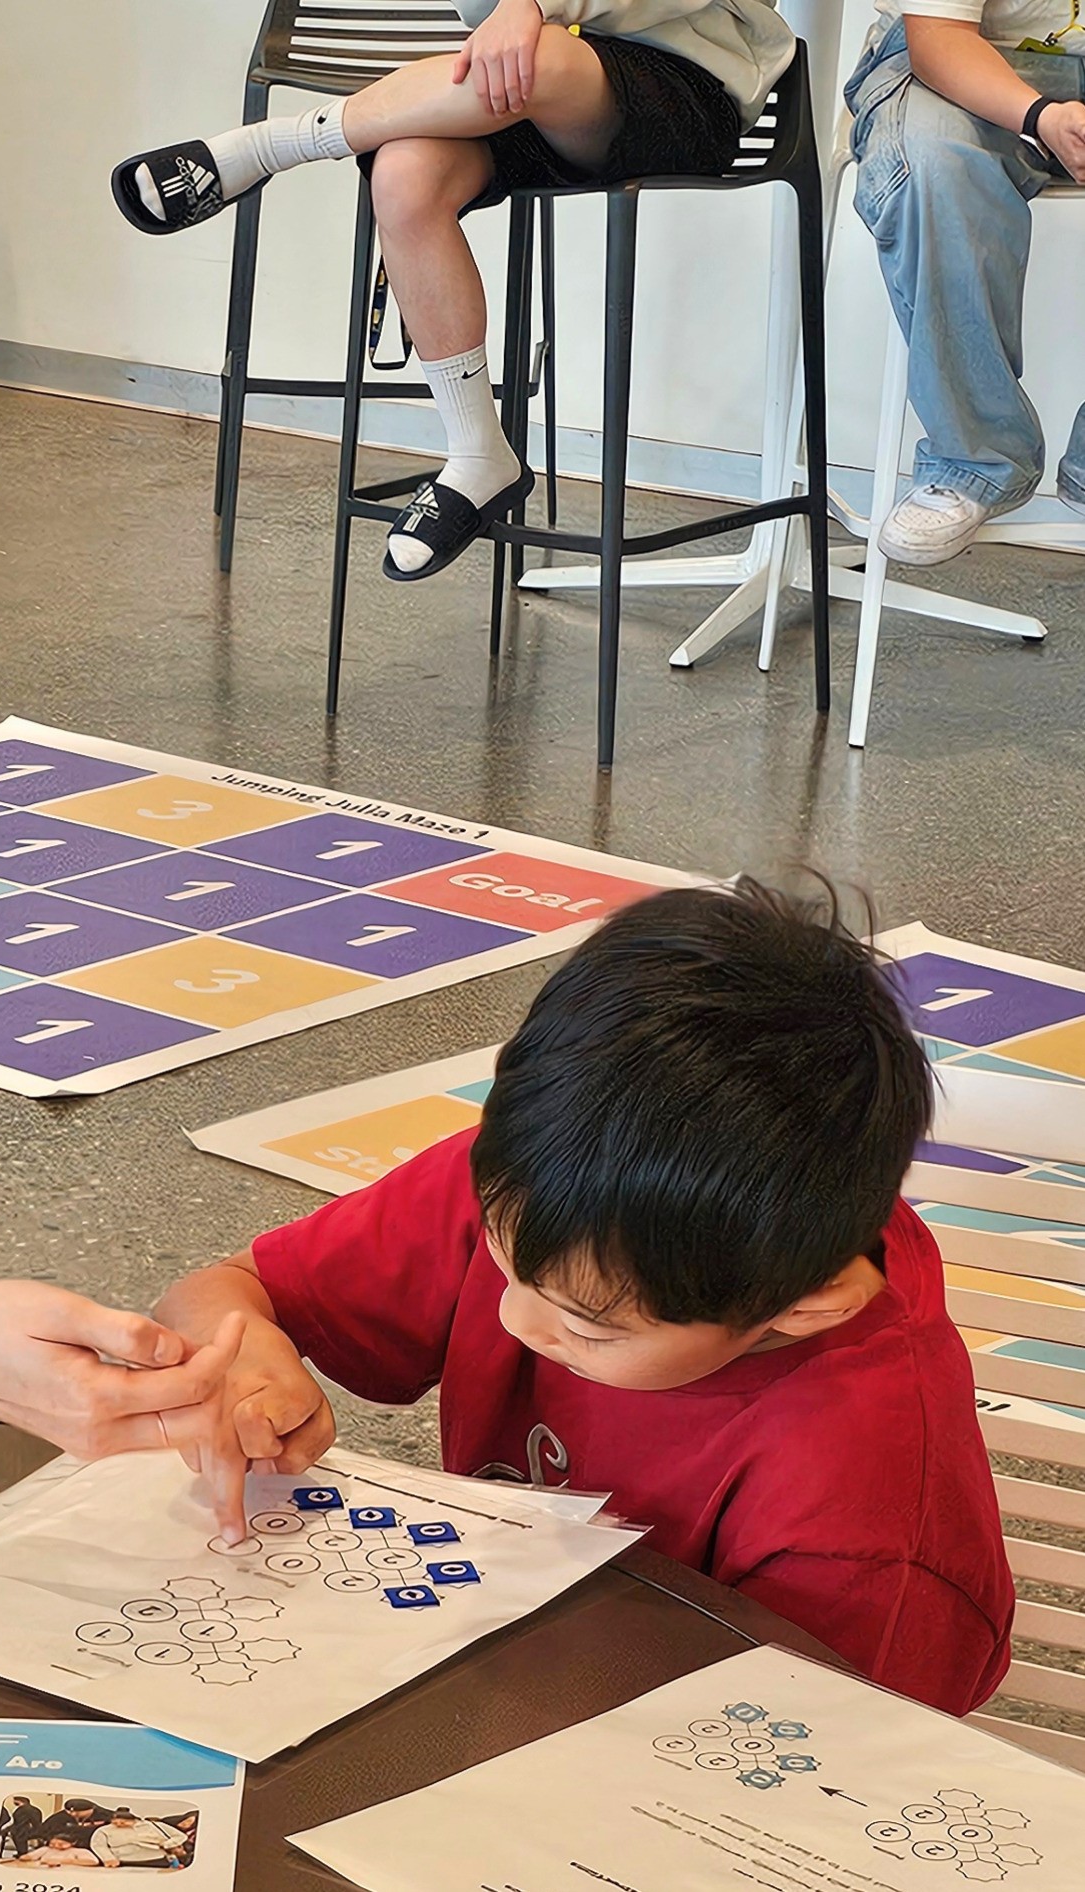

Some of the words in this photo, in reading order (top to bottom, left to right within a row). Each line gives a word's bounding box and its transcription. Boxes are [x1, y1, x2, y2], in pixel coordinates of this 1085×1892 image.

[136, 800, 212, 820] 3
[211, 773, 326, 804] Jumping
[324, 798, 390, 819] Julia
[394, 812, 467, 836] Maze
[473, 829, 490, 840] 1
[316, 839, 383, 860] 1
[164, 880, 236, 901] 1
[447, 872, 604, 915] Goal
[5, 923, 80, 945] 1
[346, 925, 416, 947] 1
[173, 968, 260, 994] 3
[919, 987, 993, 1012] 1
[14, 1019, 94, 1044] 1
[5, 1755, 63, 1770] Are
